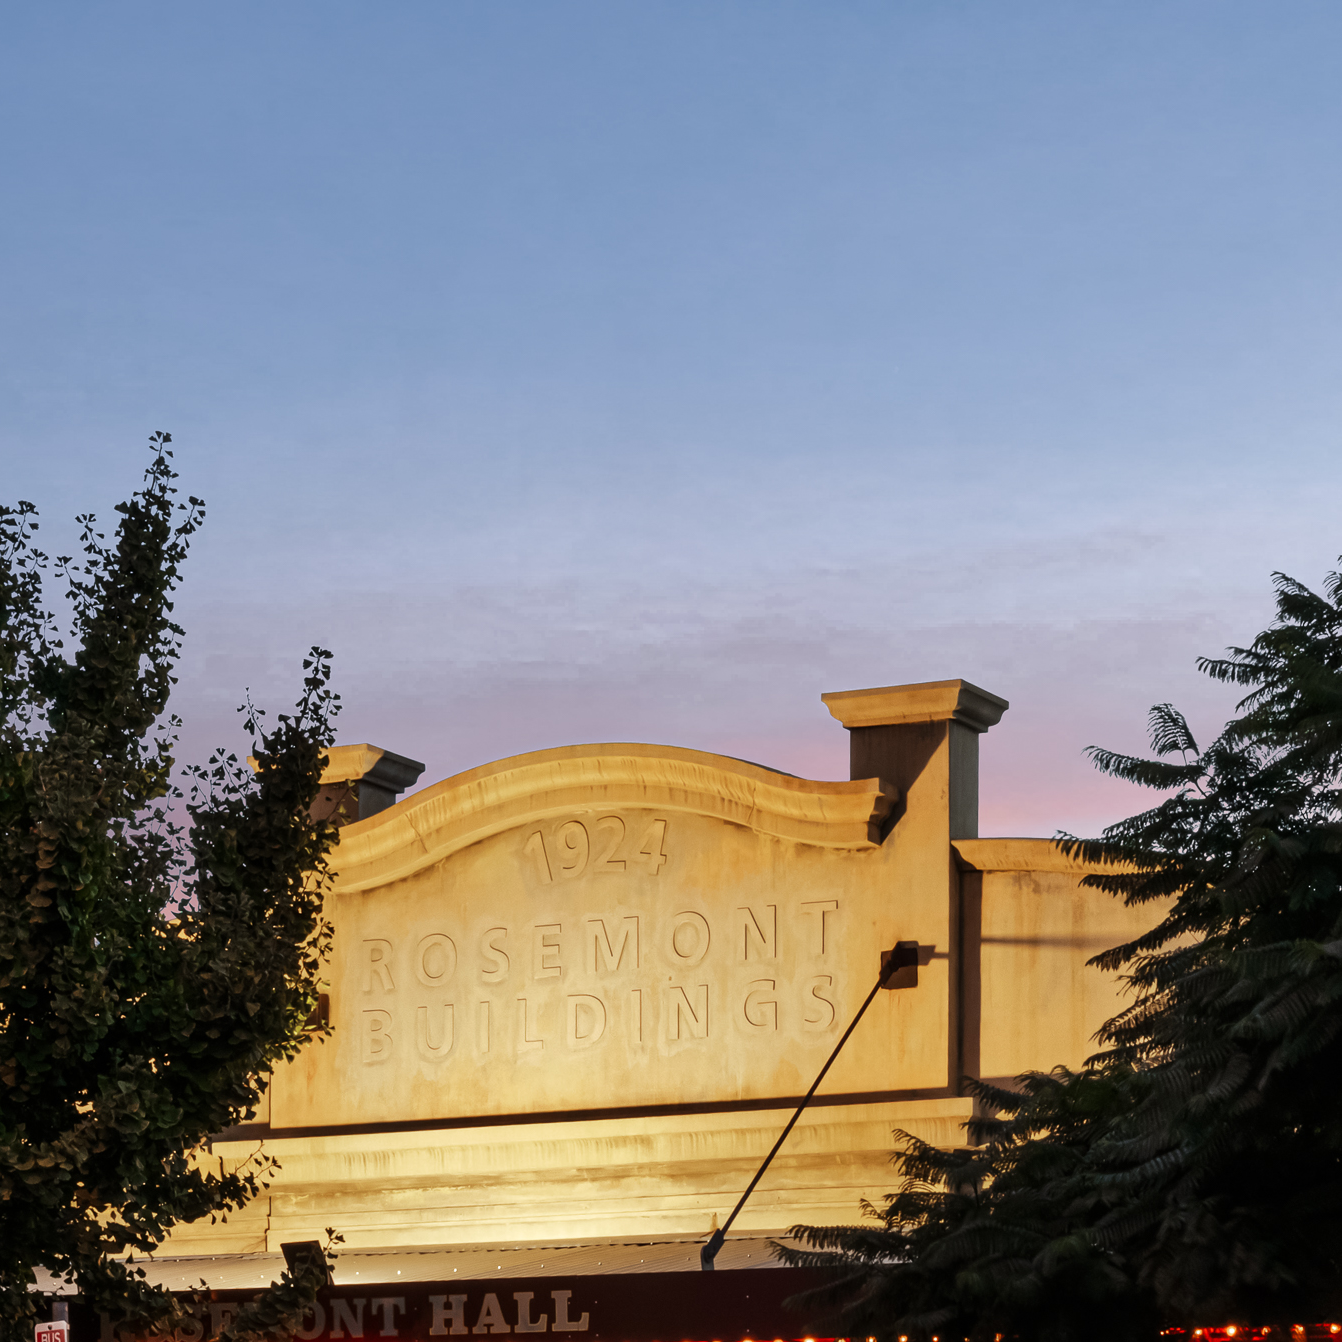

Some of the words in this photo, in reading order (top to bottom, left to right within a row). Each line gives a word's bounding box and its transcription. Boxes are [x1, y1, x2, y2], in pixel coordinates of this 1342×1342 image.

[523, 815, 668, 885] 1924
[361, 899, 839, 997] ROSEMONT
[361, 974, 837, 1065] BUILDINGS
[428, 1289, 590, 1336] HALL
